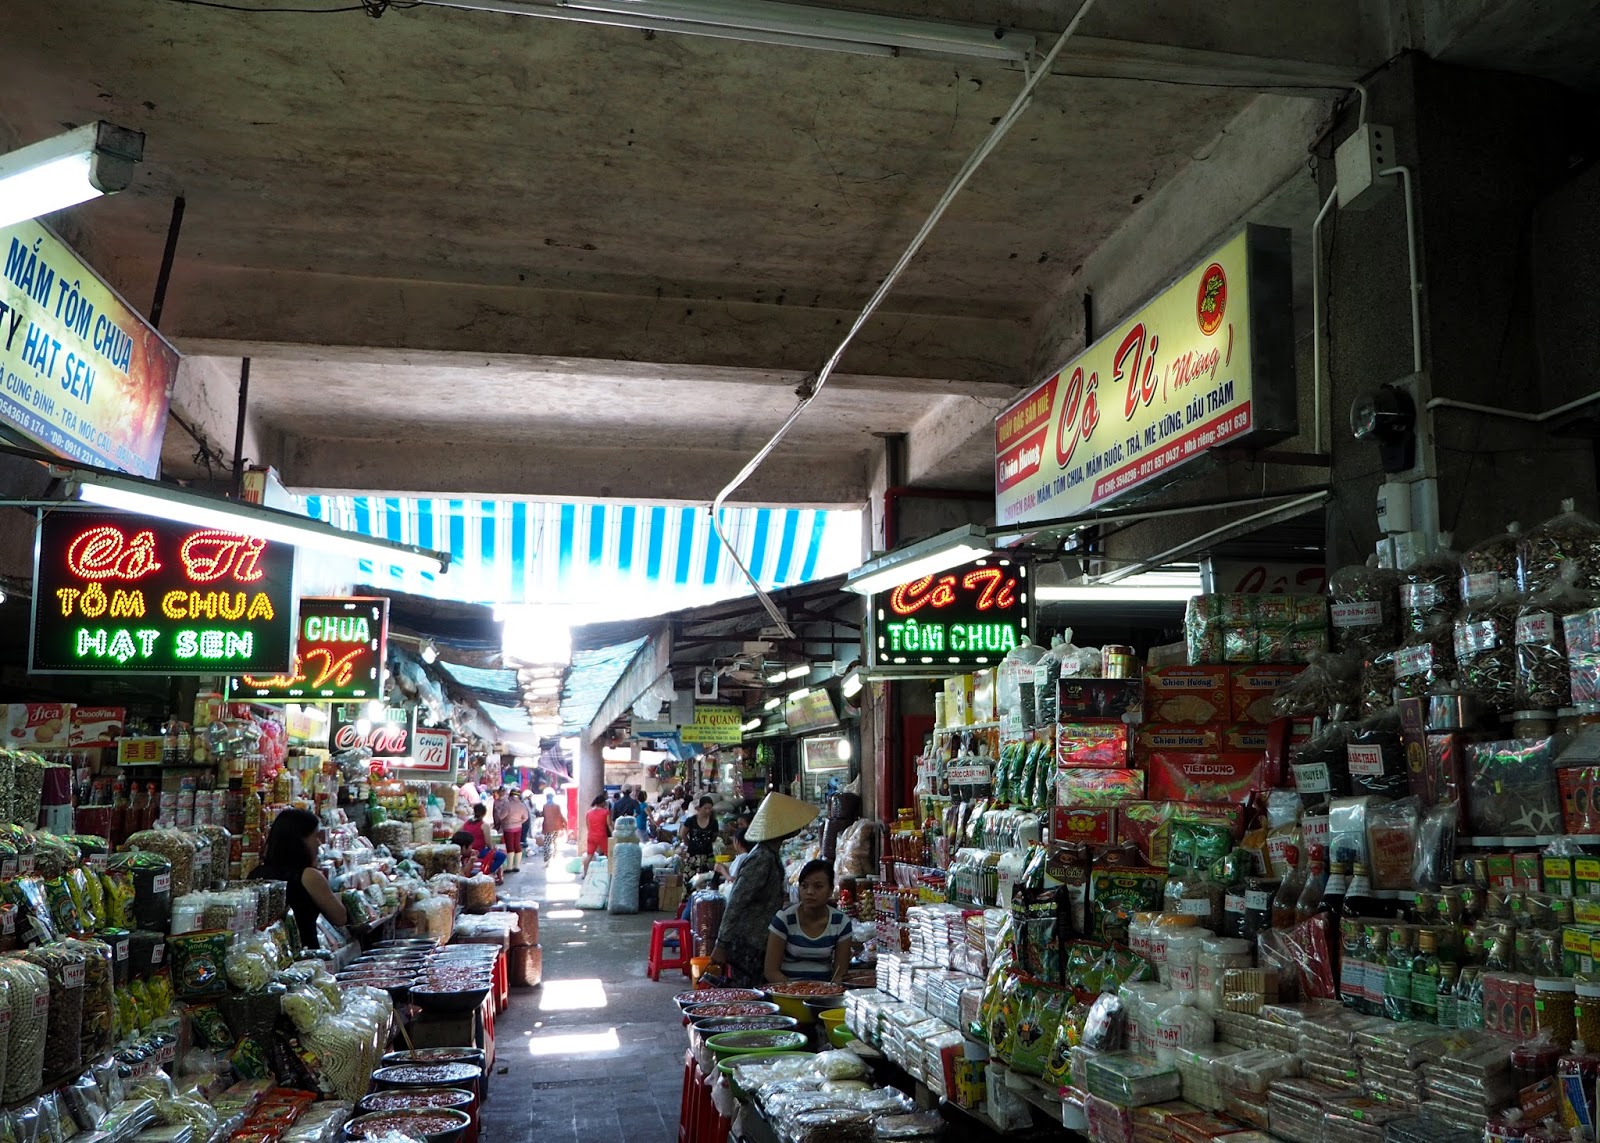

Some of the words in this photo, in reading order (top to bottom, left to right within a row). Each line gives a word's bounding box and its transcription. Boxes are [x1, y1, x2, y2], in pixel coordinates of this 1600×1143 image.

[4, 237, 55, 308] MẮM
[55, 280, 94, 340] TÔM
[94, 313, 133, 374] CHUA
[22, 321, 62, 379] HẠT
[61, 352, 96, 404] SEN
[6, 372, 32, 401] CUNG
[32, 389, 55, 417] ĐÌNH
[61, 407, 78, 431] TRÀ
[1056, 366, 1100, 470] Cô
[30, 418, 44, 436] 174
[64, 440, 82, 458] 0914
[1053, 475, 1066, 496] TÔM
[1066, 466, 1085, 489] CHUA,
[1086, 452, 1102, 478] MẮM
[1126, 430, 1142, 457] TRÀ,
[1144, 421, 1156, 448] MÈ
[1186, 394, 1204, 426] DẦU
[1206, 380, 1234, 414] TRÀM
[1184, 437, 1196, 455] Nhà
[1198, 432, 1216, 449] riêng:
[1233, 412, 1247, 429] 639
[56, 582, 147, 618] TÔM
[162, 590, 275, 620] CHUA
[76, 628, 161, 664] HẠT
[175, 630, 253, 659] SEN
[304, 616, 370, 643] CHUA
[887, 618, 945, 652] TÔM
[950, 624, 1017, 652] CHUA
[710, 714, 740, 726] QUANG
